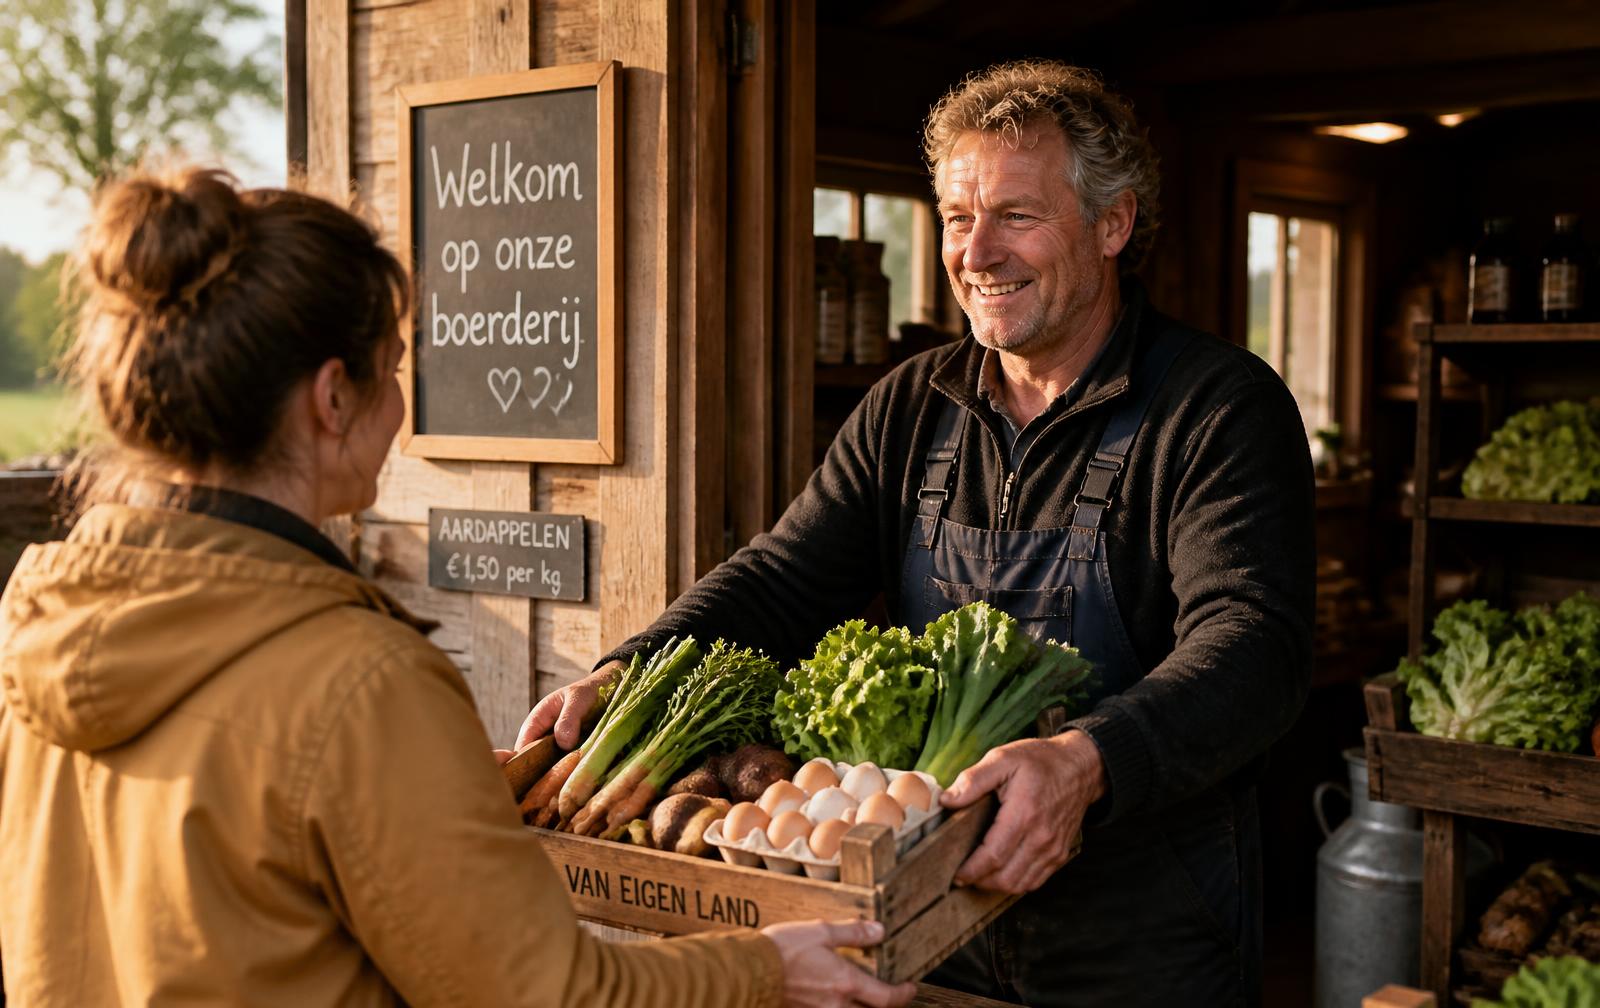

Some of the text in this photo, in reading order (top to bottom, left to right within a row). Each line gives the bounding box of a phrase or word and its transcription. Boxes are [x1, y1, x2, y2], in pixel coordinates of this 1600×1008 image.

[430, 140, 583, 209] Welkom
[441, 233, 576, 294] op onze
[432, 290, 581, 369] boerderij
[438, 516, 571, 550] AARDAPPELEN
[446, 552, 562, 596] €1,50 per kg
[564, 864, 760, 928] VAN EIGEN LAND
